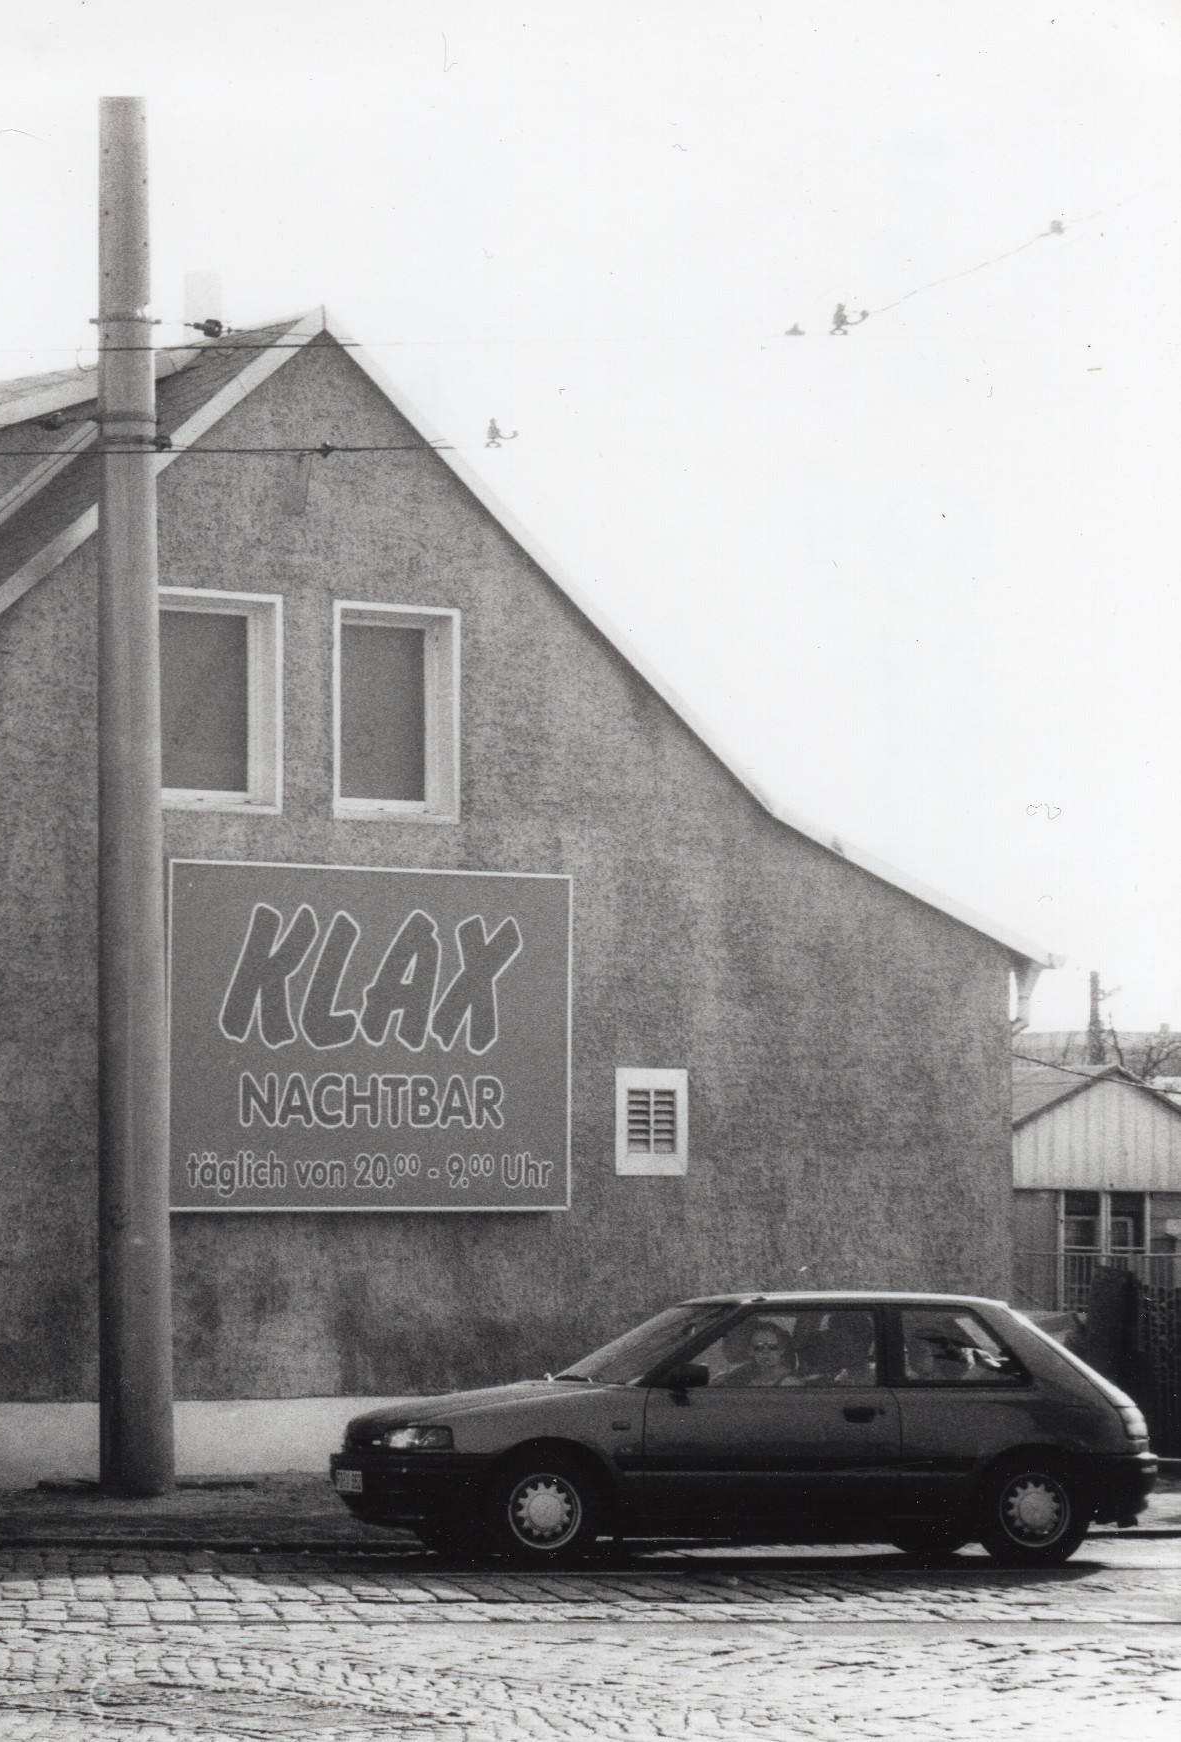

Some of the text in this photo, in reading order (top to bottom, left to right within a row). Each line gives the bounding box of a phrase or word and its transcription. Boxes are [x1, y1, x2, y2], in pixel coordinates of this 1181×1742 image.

[219, 902, 522, 1055] KLAX
[239, 1072, 504, 1128] NACHTBAR
[186, 1151, 287, 1197] täglich
[295, 1159, 346, 1188] von
[428, 1166, 440, 1179] -
[502, 1152, 553, 1188] Uhr
